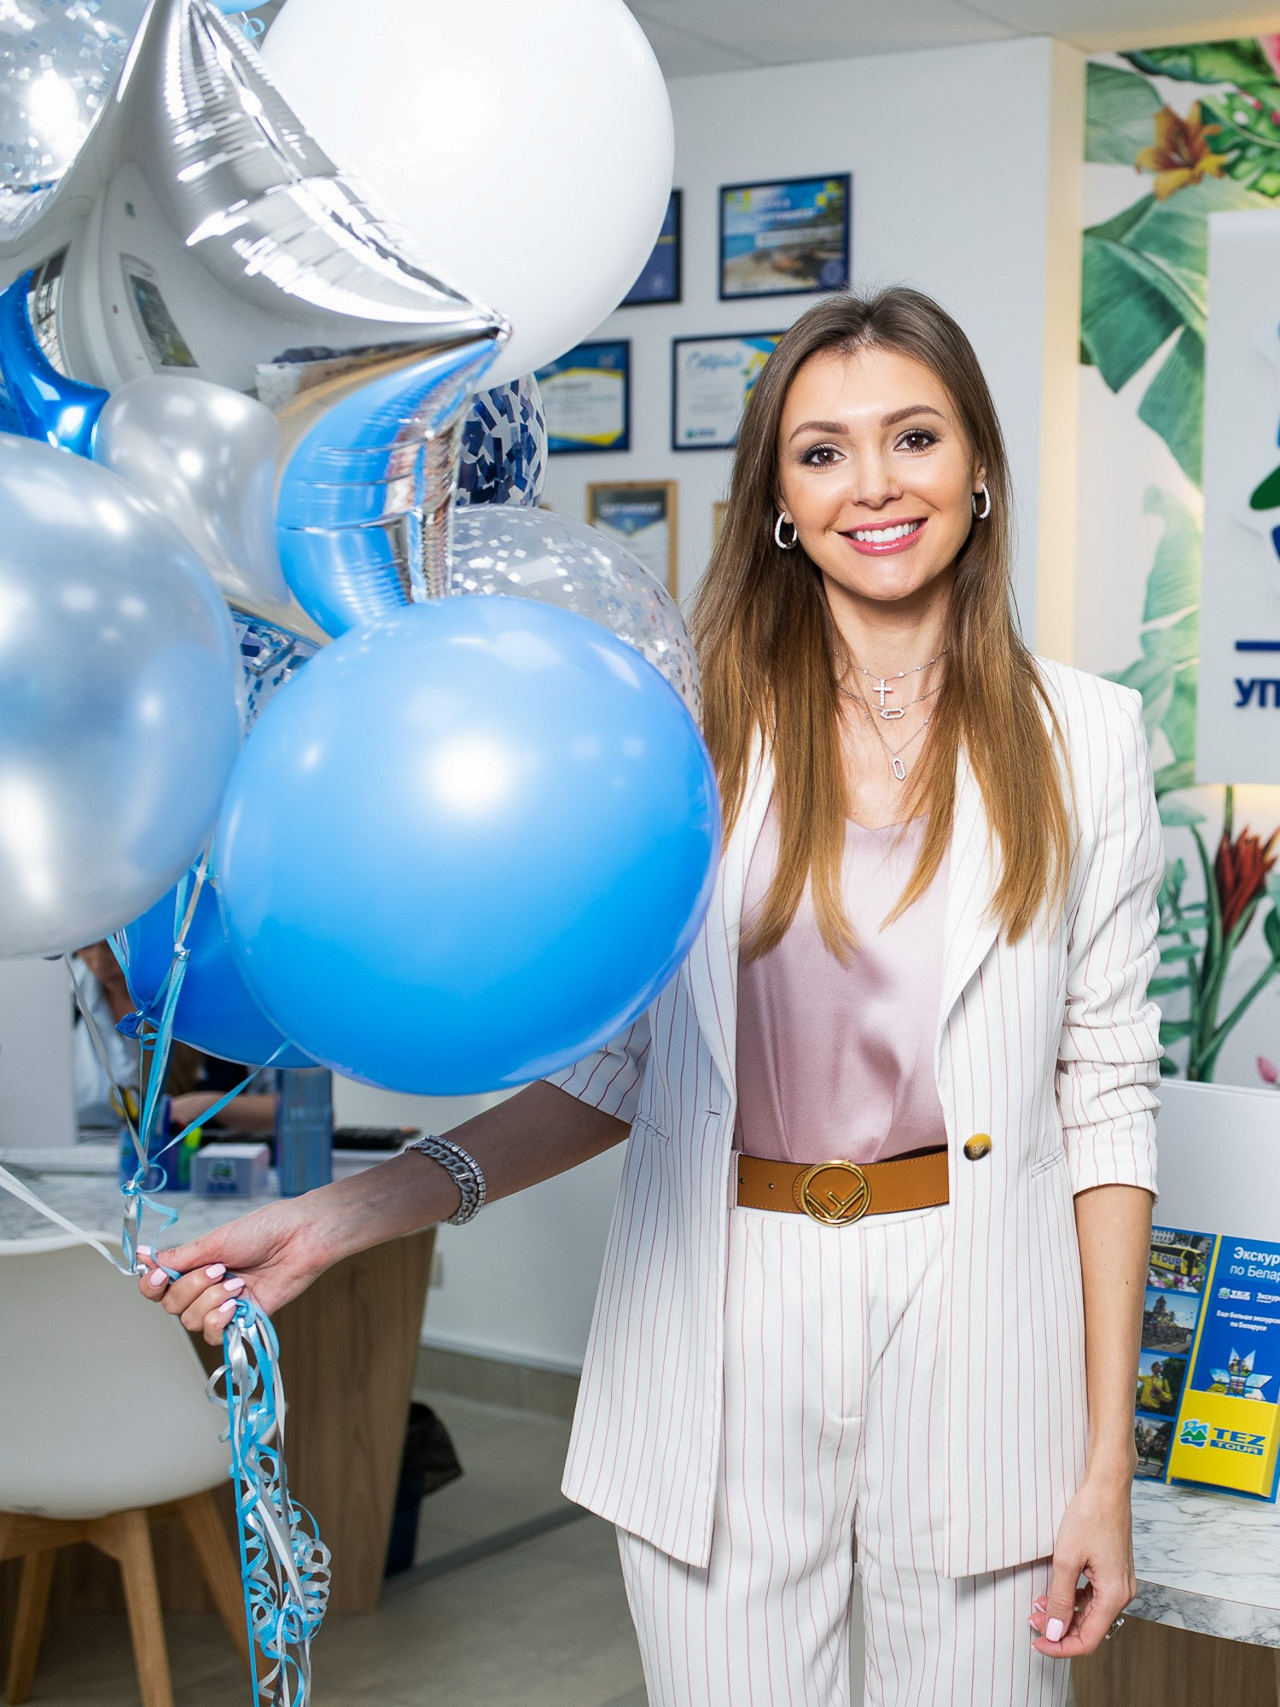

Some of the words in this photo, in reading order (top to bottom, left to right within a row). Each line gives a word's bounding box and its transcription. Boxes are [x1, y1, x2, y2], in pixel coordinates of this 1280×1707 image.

[1156, 1252, 1183, 1268] TOUR
[1229, 1265, 1246, 1276] по
[1213, 1427, 1266, 1447] TEZ
[1217, 1442, 1259, 1454] TOUR
